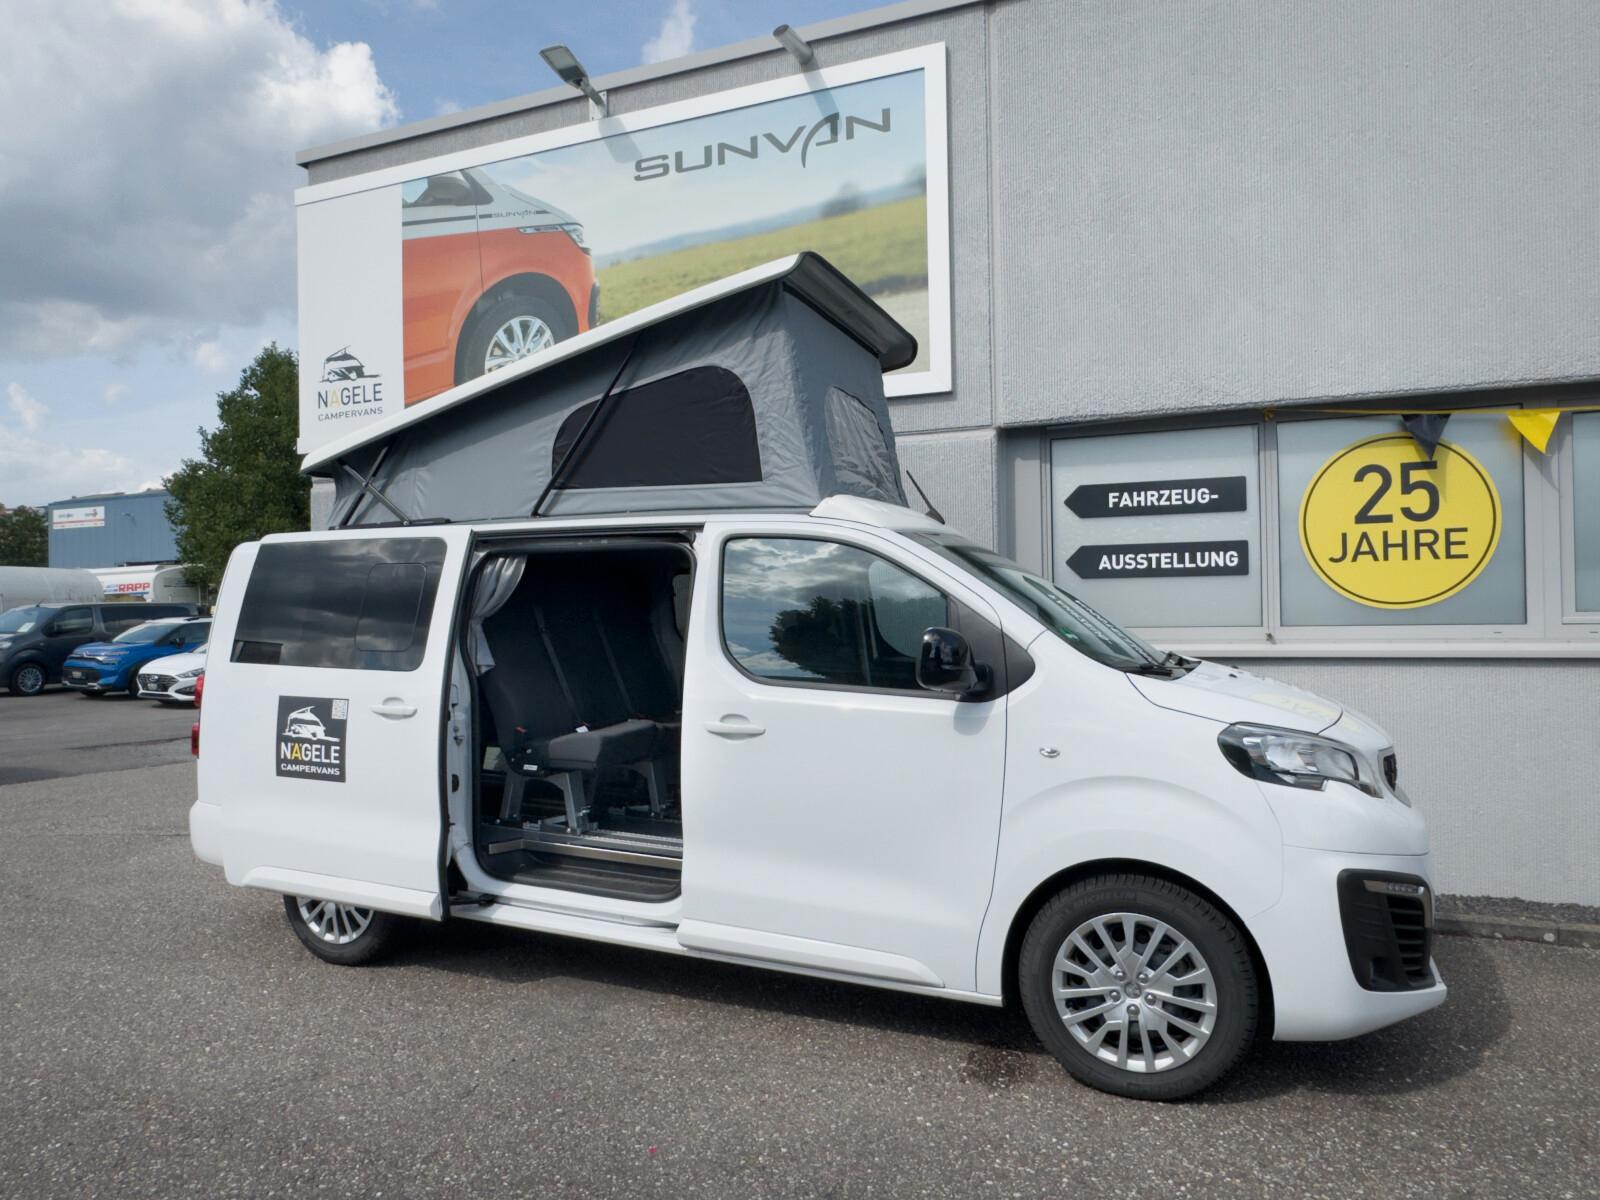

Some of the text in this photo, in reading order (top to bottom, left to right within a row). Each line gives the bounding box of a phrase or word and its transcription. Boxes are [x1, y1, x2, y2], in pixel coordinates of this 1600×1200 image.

[633, 107, 891, 182] SUNVAN
[317, 406, 384, 422] CAMPERVANS
[1108, 488, 1219, 508] FAHRZEUG-
[1353, 460, 1440, 525] 25
[1328, 527, 1470, 564] JAHRE
[1098, 551, 1240, 570] AUSSTELLUNG
[118, 582, 151, 593] RAPP
[280, 763, 341, 776] CAMPERVANS
